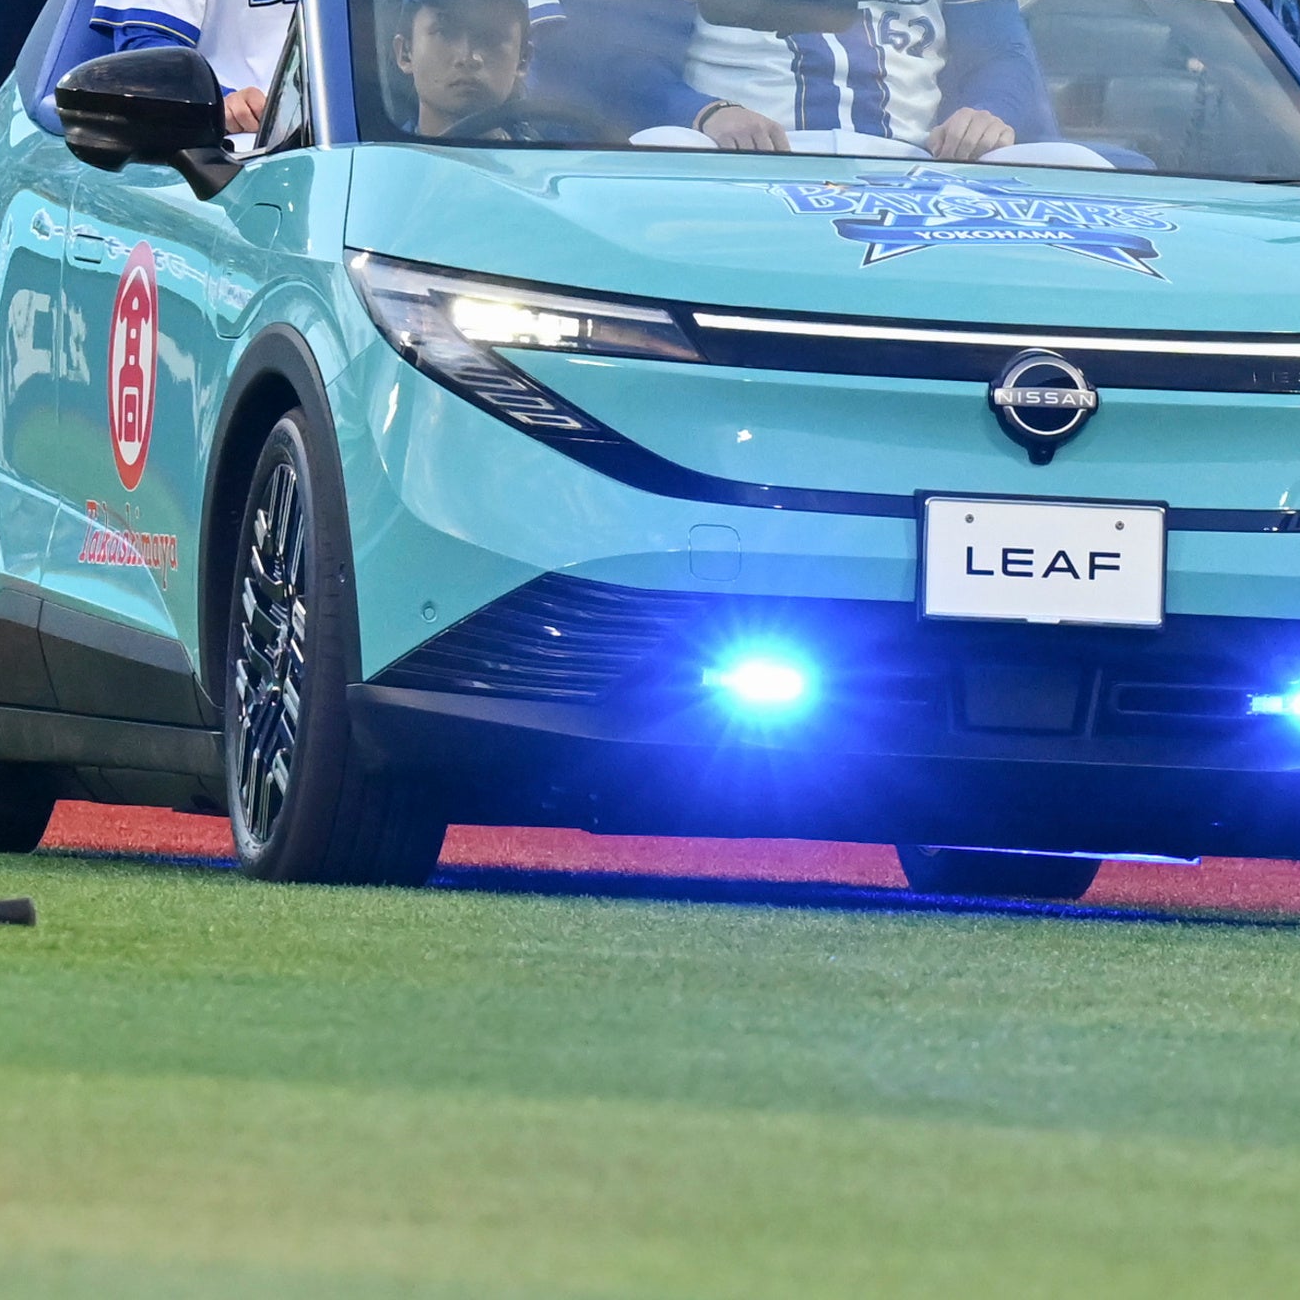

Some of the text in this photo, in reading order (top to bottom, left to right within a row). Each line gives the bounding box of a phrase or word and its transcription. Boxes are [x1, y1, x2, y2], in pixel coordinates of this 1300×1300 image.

[774, 182, 1181, 232] BAYSTARS
[914, 230, 1076, 241] YOKOHAMA
[998, 390, 1095, 408] NISSAN
[965, 546, 1122, 580] LEAF
